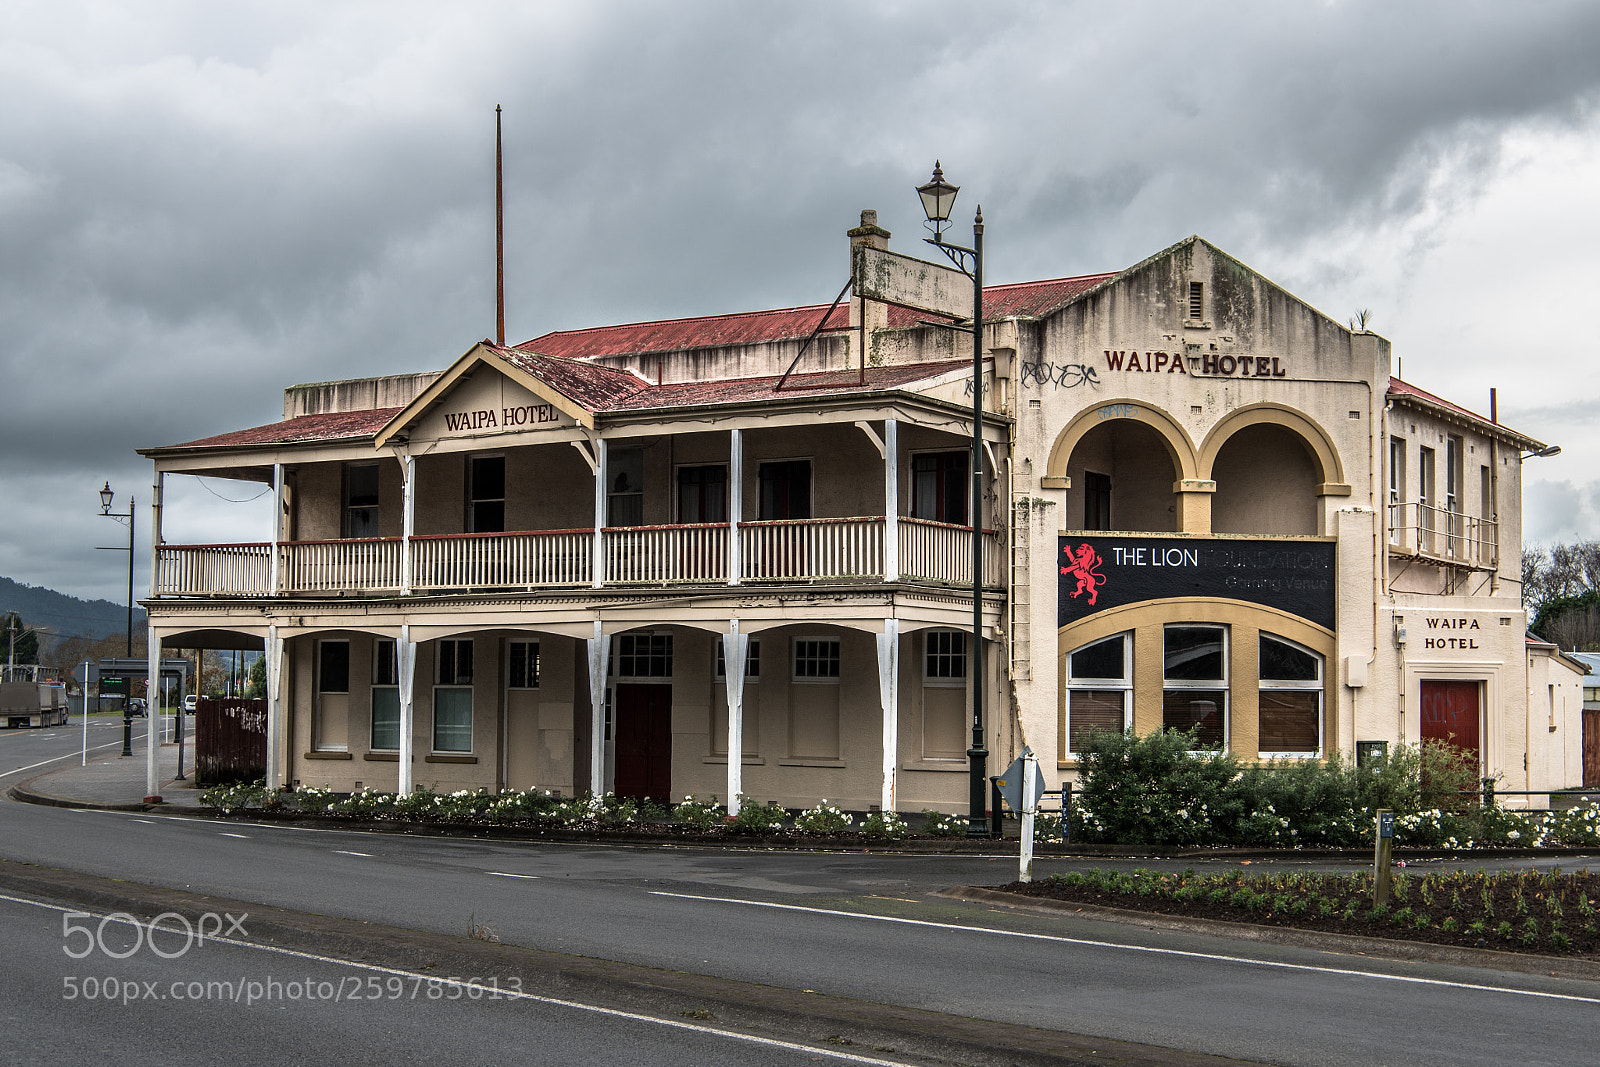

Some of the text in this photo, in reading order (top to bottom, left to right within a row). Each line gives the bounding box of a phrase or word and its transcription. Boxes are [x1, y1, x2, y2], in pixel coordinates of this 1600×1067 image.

[1105, 350, 1286, 377] WAIPA HOTEL
[444, 403, 559, 432] WAIPA HOTEL
[1112, 547, 1330, 569] THE LION FOUNDATION
[1286, 577, 1328, 590] Venue
[1426, 618, 1481, 630] WAIPA
[1425, 638, 1480, 649] HOTEL
